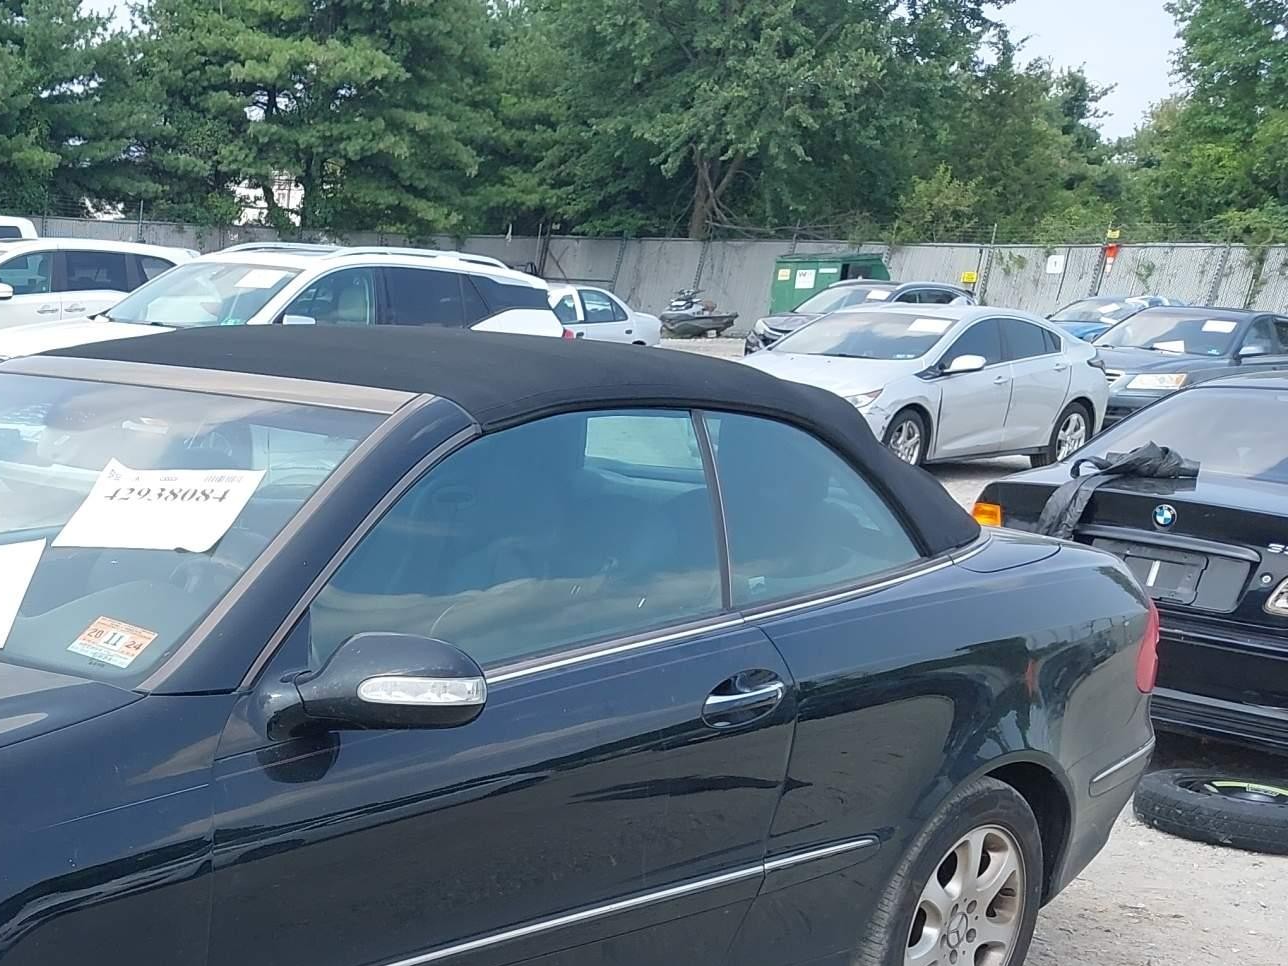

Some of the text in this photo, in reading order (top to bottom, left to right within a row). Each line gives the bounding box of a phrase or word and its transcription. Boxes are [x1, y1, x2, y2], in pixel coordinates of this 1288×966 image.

[103, 487, 231, 503] 42938084
[1267, 543, 1288, 555] 3
[87, 627, 143, 650] 20 11 24
